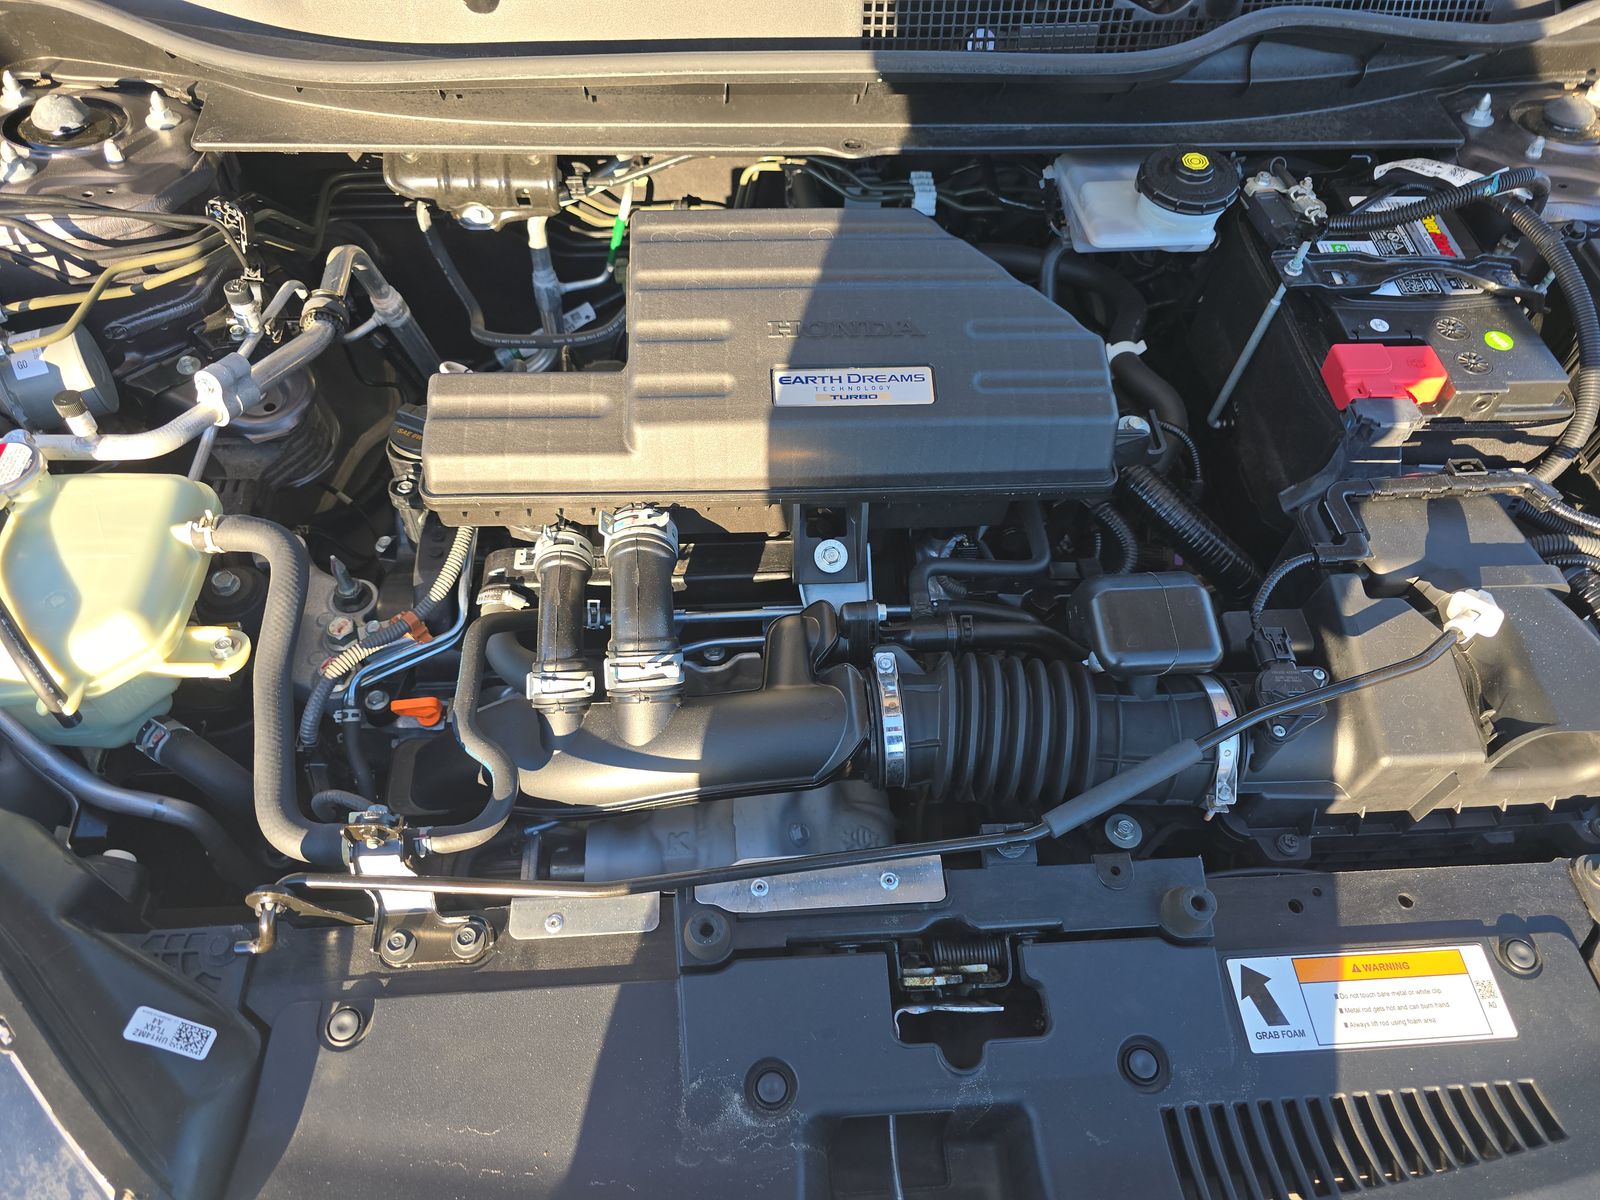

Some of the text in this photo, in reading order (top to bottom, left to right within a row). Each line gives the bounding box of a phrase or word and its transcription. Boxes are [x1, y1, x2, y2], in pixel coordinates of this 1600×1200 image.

[767, 320, 926, 338] HONDA
[778, 373, 925, 385] EARTH DREAMS
[1361, 961, 1410, 972] WARNING
[1339, 992, 1349, 1000] Do
[1372, 1005, 1386, 1014] gets
[1255, 1029, 1306, 1041] GRAB FOAM
